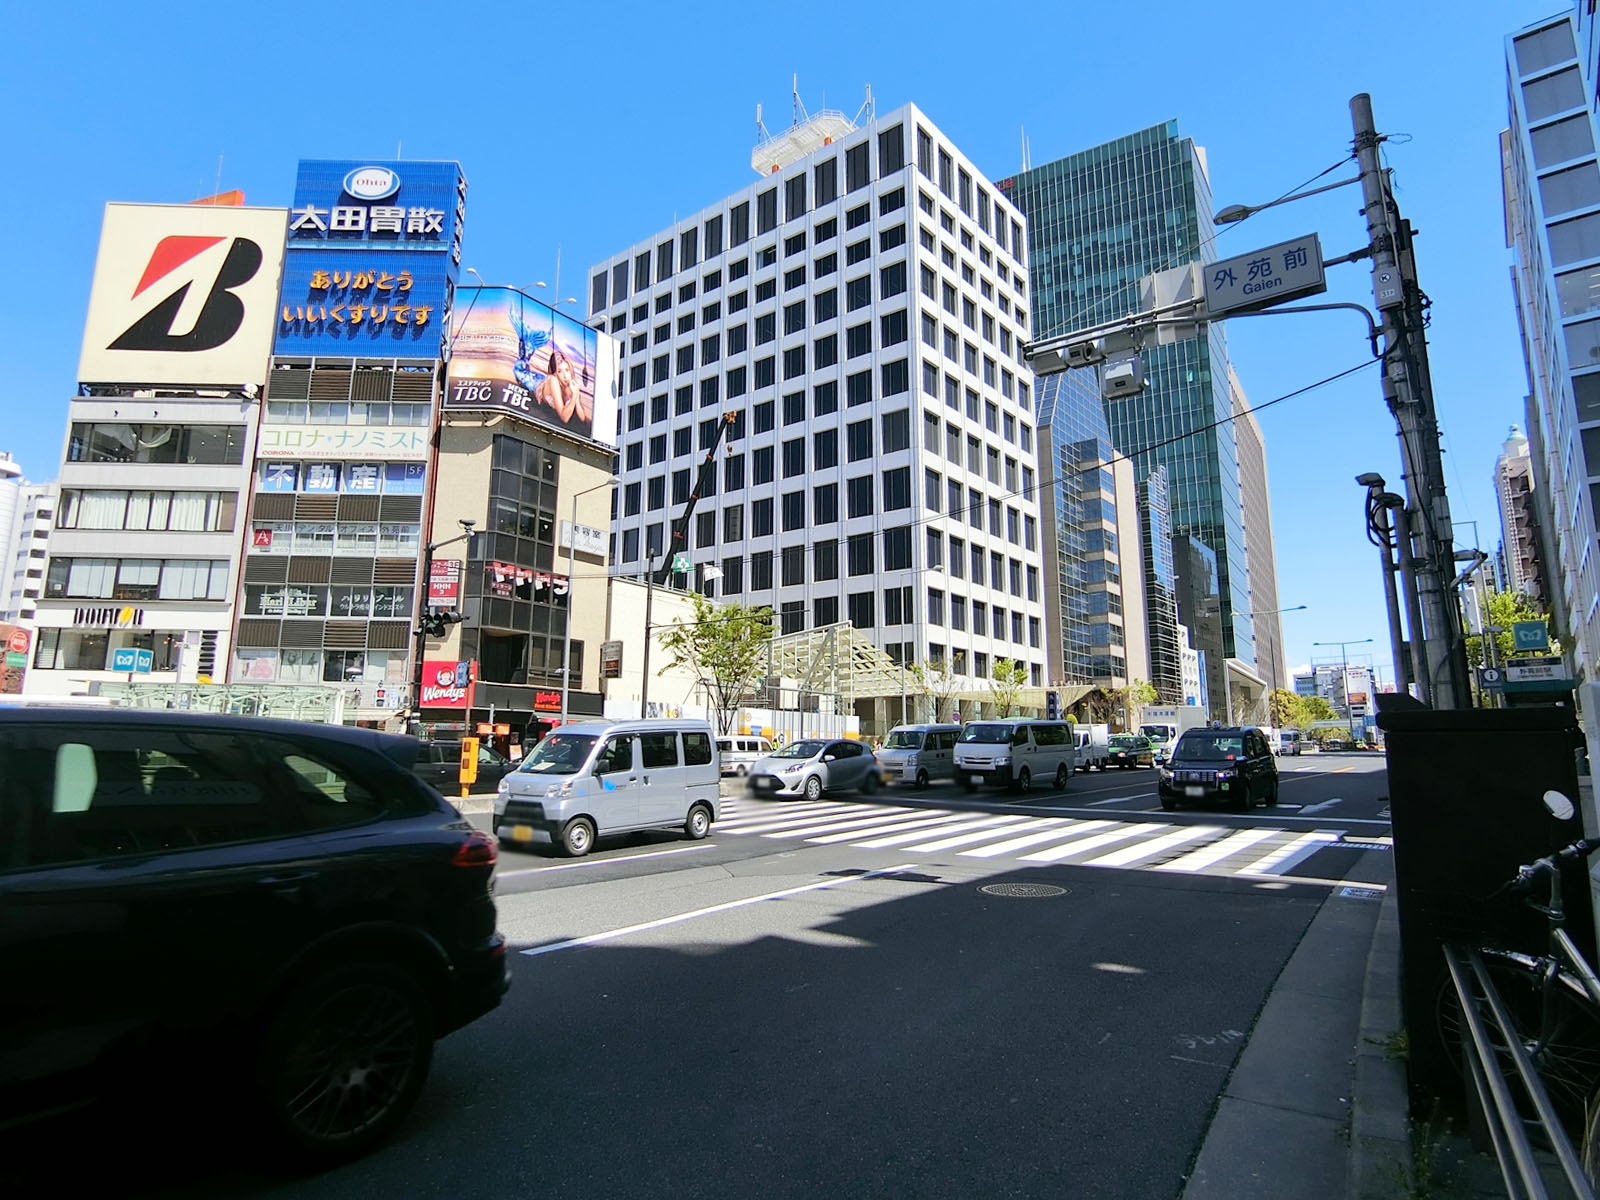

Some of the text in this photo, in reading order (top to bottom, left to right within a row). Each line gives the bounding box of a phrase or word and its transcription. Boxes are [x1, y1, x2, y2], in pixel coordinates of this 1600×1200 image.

[356, 178, 387, 187] Ohta
[289, 204, 445, 234] 太田胃散
[1214, 246, 1308, 291] 外苑前
[310, 269, 413, 290] ありがとう
[1242, 277, 1283, 296] Gaien
[283, 304, 433, 325] いいくすりです
[453, 386, 492, 401] TBC
[502, 388, 532, 411] TBC
[508, 383, 529, 396] MEN'S
[267, 464, 378, 490] 不動産
[409, 466, 423, 475] 5F
